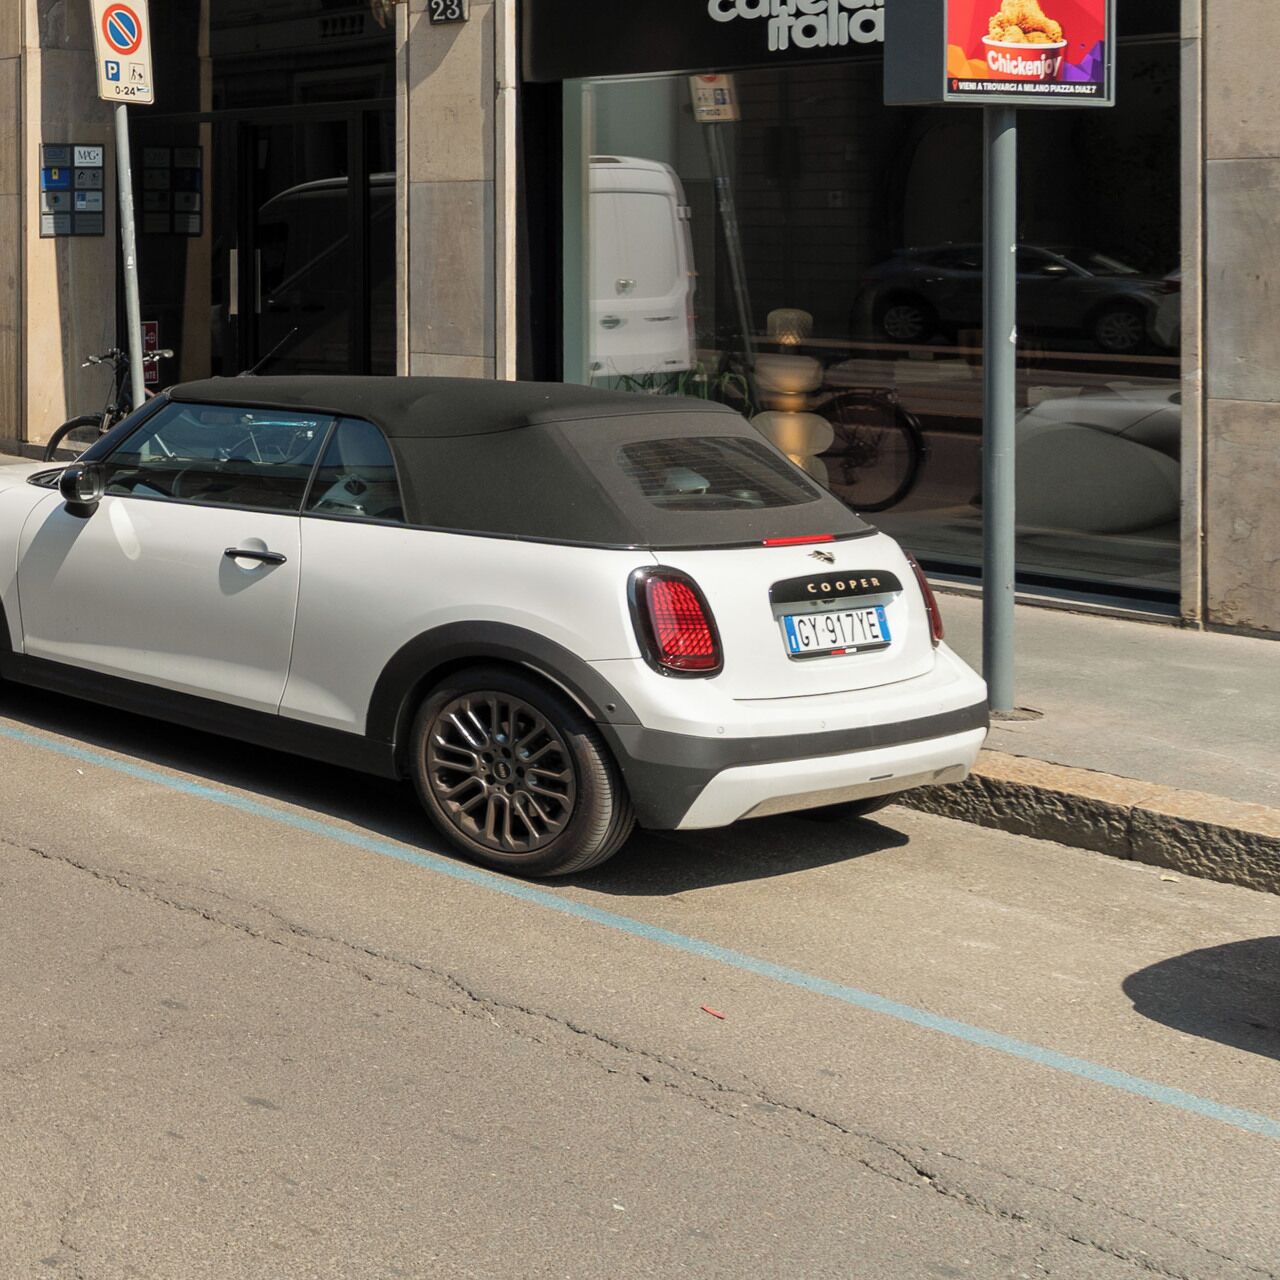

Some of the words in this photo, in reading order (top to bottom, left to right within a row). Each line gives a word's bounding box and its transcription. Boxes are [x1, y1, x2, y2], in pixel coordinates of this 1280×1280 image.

[107, 62, 118, 80] P
[986, 50, 1062, 80] Chickenjoy
[115, 85, 136, 96] 0-24
[807, 577, 880, 593] COOPER
[797, 617, 820, 647] GY
[825, 611, 880, 645] 917YE
